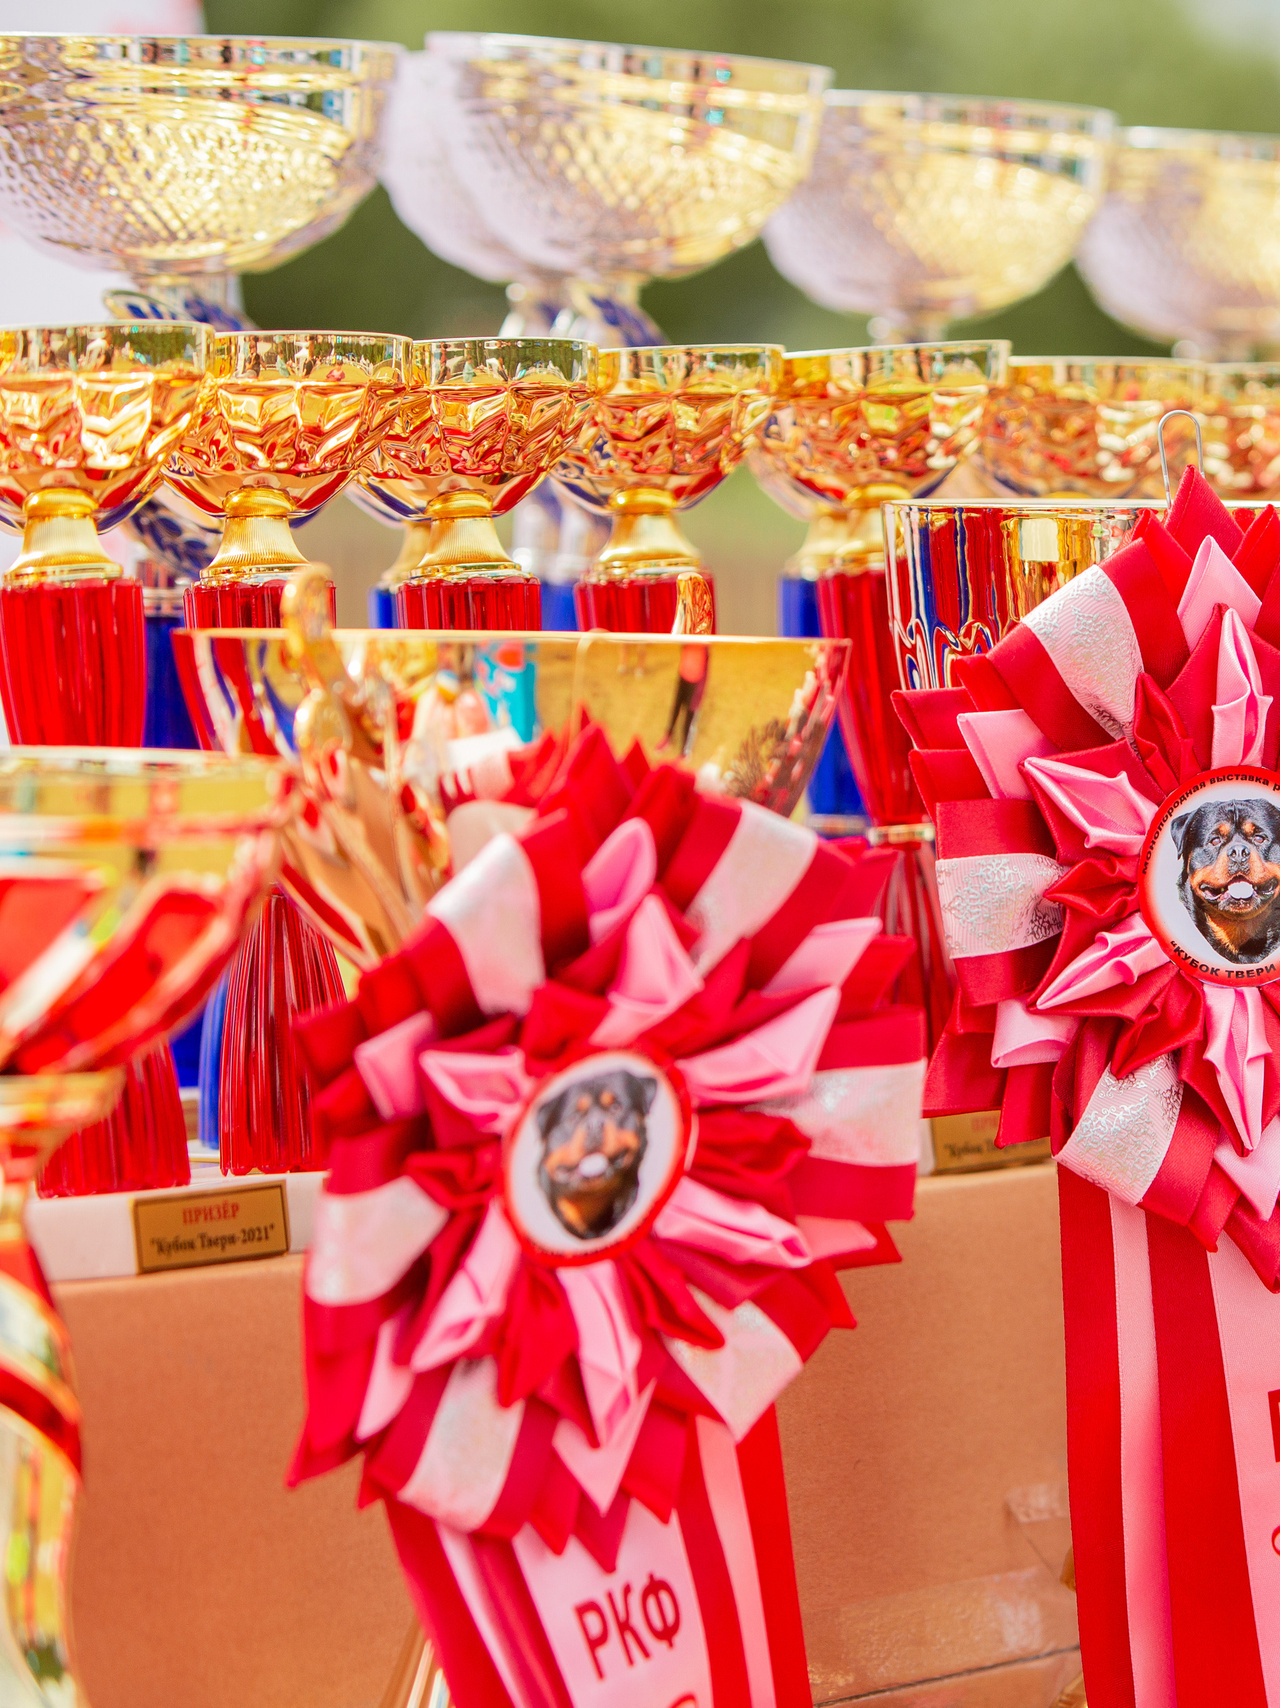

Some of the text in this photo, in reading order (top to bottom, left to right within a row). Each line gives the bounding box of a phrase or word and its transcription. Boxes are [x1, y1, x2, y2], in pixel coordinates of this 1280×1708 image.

[1142, 781, 1207, 875] монопородная
[1209, 773, 1270, 786] выставка
[1225, 963, 1277, 979] ТВЕРИ
[182, 1200, 240, 1225] ПРИЗЁР
[575, 1572, 680, 1680] РКФ
